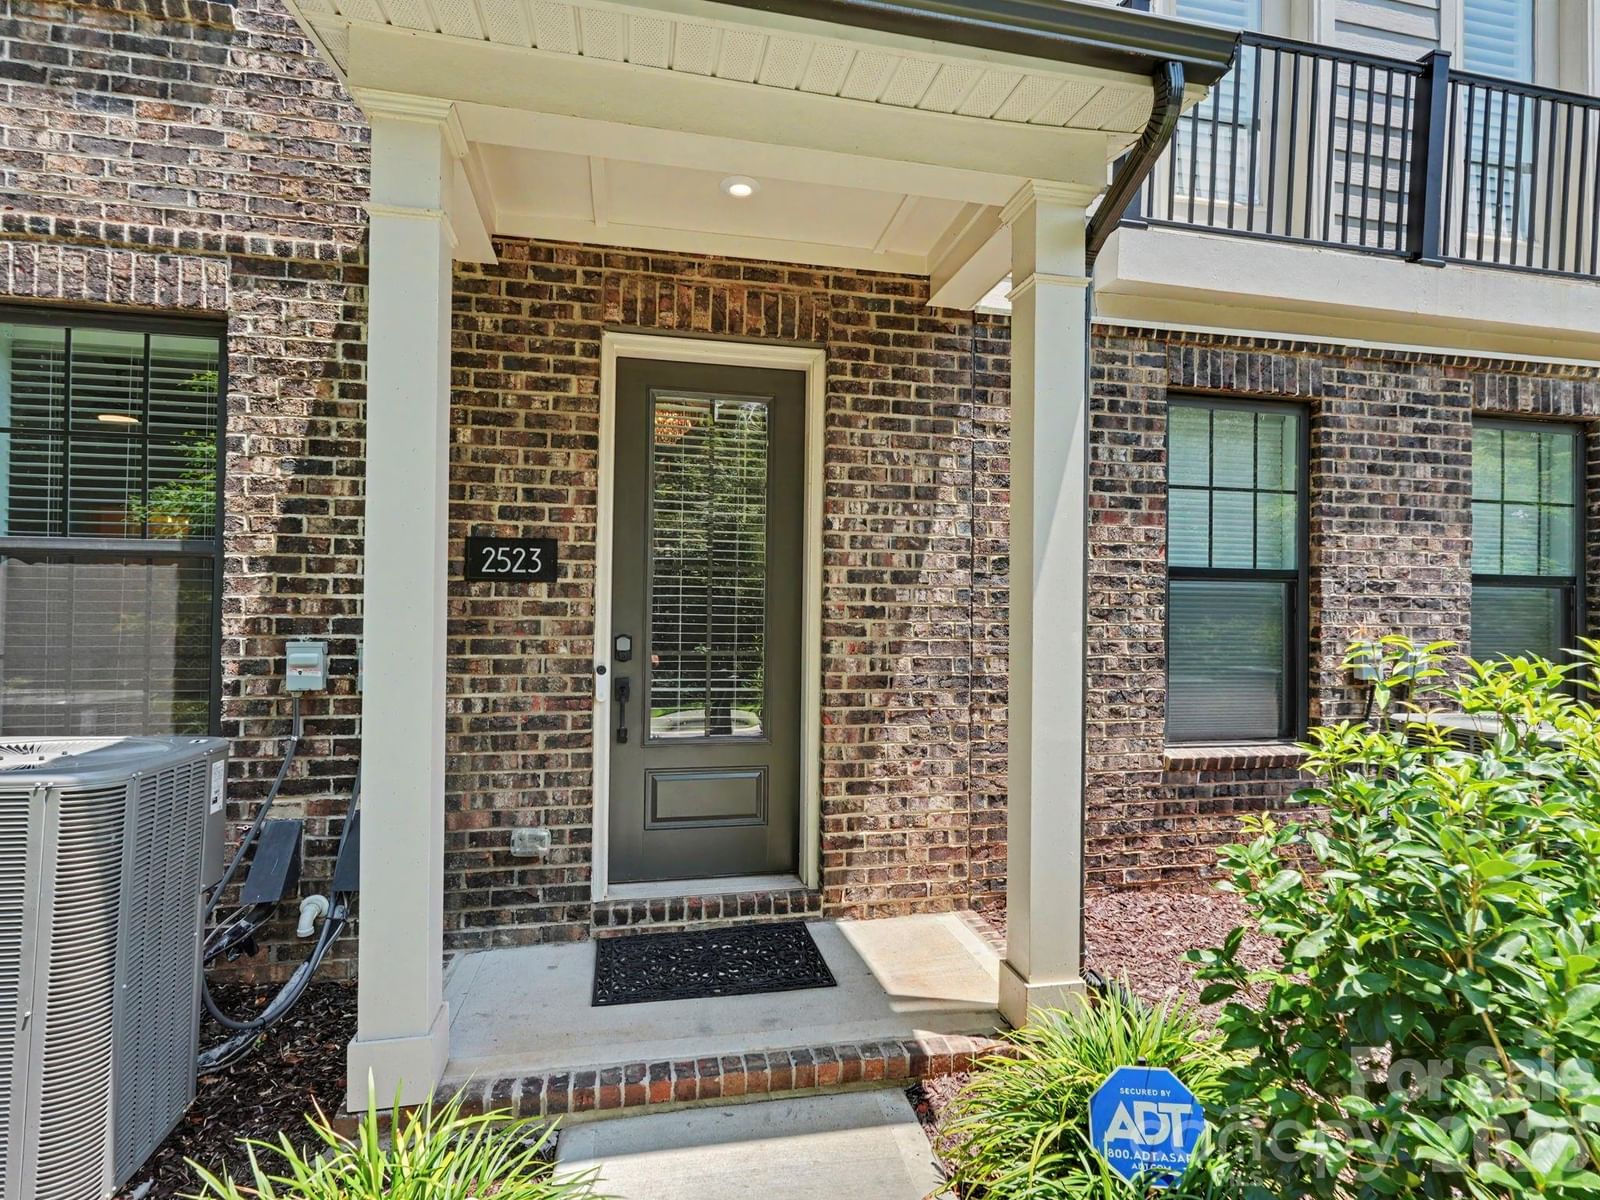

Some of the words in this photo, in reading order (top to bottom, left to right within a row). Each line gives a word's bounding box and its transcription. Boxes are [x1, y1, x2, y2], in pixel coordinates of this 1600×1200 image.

[481, 546, 542, 573] 2523
[1119, 1087, 1159, 1097] SECURED
[1160, 1089, 1171, 1098] BY
[1103, 1100, 1192, 1148] ADT
